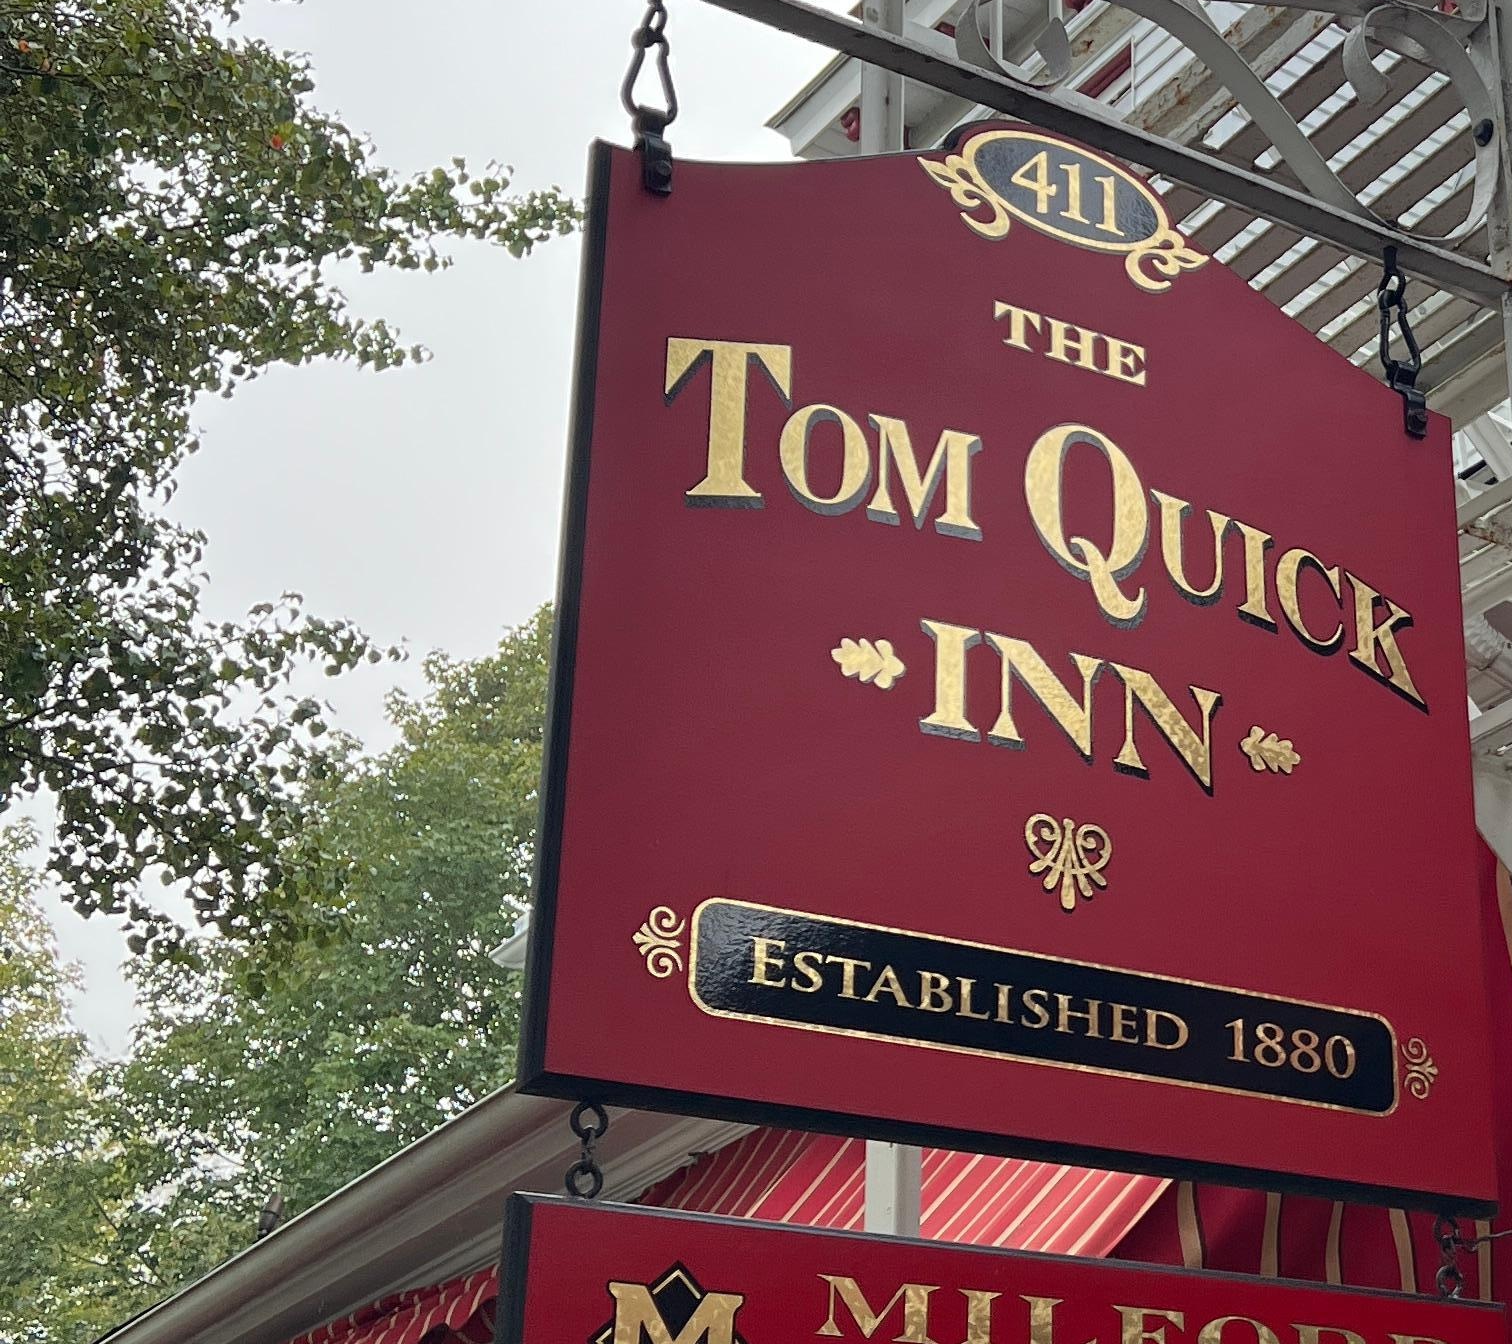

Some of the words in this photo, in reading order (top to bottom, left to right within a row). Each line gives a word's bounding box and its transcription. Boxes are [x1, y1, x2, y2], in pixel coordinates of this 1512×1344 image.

[1010, 150, 1126, 236] 411
[992, 299, 1148, 387] THE
[664, 336, 983, 539] TOM
[1024, 421, 1429, 713] QUICK
[918, 617, 1223, 794] INN
[748, 935, 1189, 1051] ESTABLISHED
[1224, 1017, 1356, 1080] 1880
